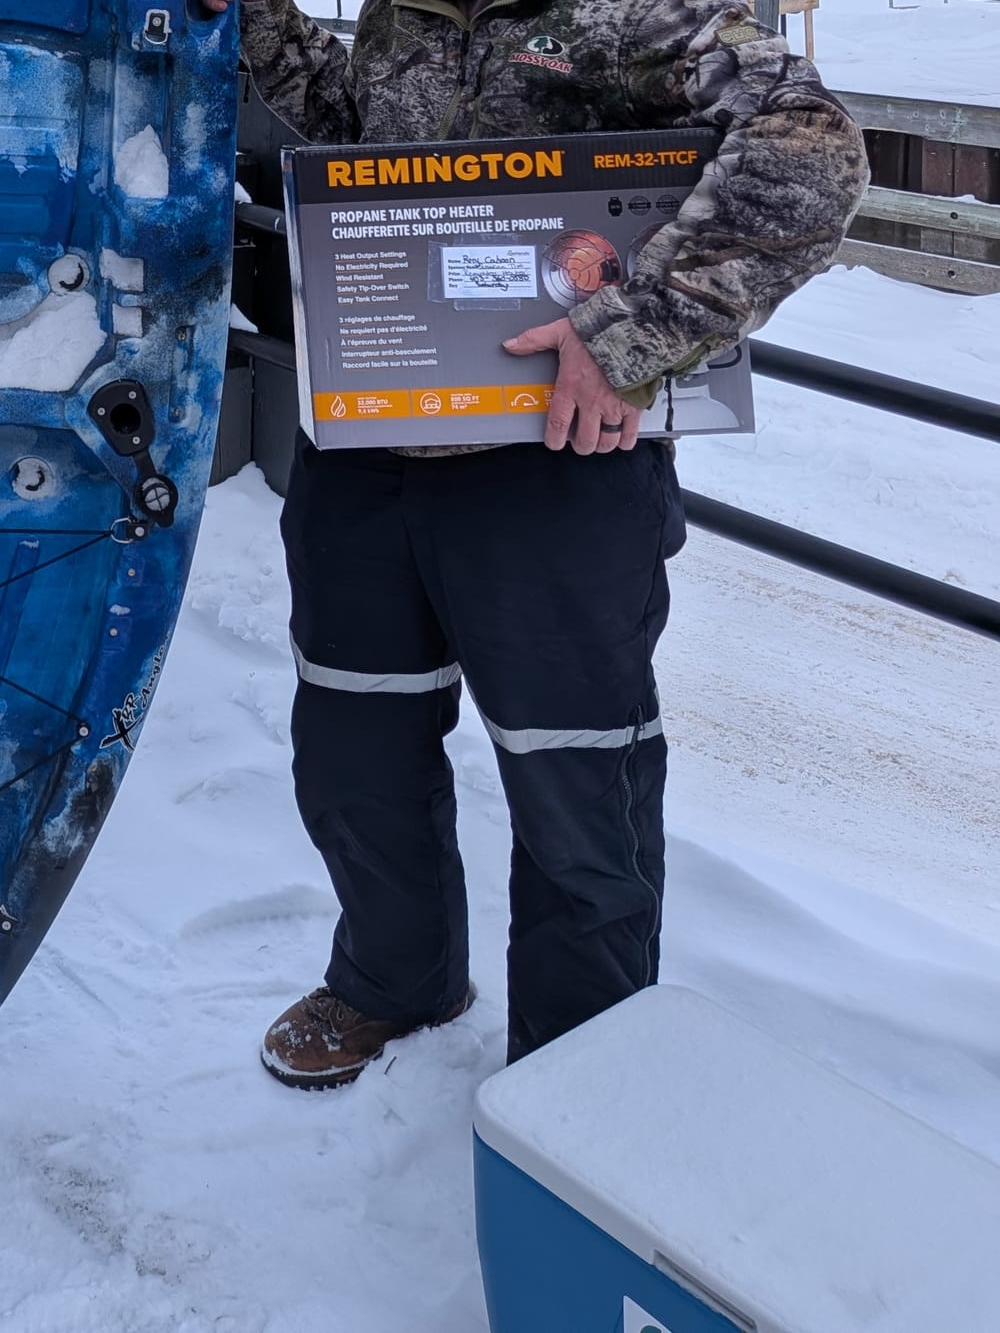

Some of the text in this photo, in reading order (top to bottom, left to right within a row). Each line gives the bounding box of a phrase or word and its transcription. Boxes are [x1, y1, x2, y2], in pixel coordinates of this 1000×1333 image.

[508, 52, 574, 73] MOSSY OAK
[594, 150, 698, 169] REM-32-TTCF
[327, 150, 563, 187] REMINGTON
[331, 204, 494, 224] PROPANE TANK TOP HEATER
[332, 217, 564, 240] CHAUFFERETTE SUR BOUTEILLE DE PROPANE
[356, 252, 379, 261] Output
[379, 251, 407, 259] Settings
[346, 263, 378, 271] Electricity
[379, 261, 409, 270] Required
[335, 273, 384, 282] Wind Resistant
[337, 285, 358, 293] Safety
[358, 284, 387, 292] Tip-Over
[337, 296, 354, 304] Easy
[371, 294, 399, 302] Connect
[344, 316, 373, 324] réglages
[382, 314, 416, 322] chauffage
[350, 327, 376, 336] requiert
[389, 324, 428, 333] d'électricité
[347, 339, 378, 347] l'épreuve
[341, 347, 437, 358] Interrupteur anti-basculement
[342, 361, 370, 369] Raccord
[370, 360, 389, 368] facile
[401, 359, 409, 367] la
[409, 358, 438, 367] bouteille
